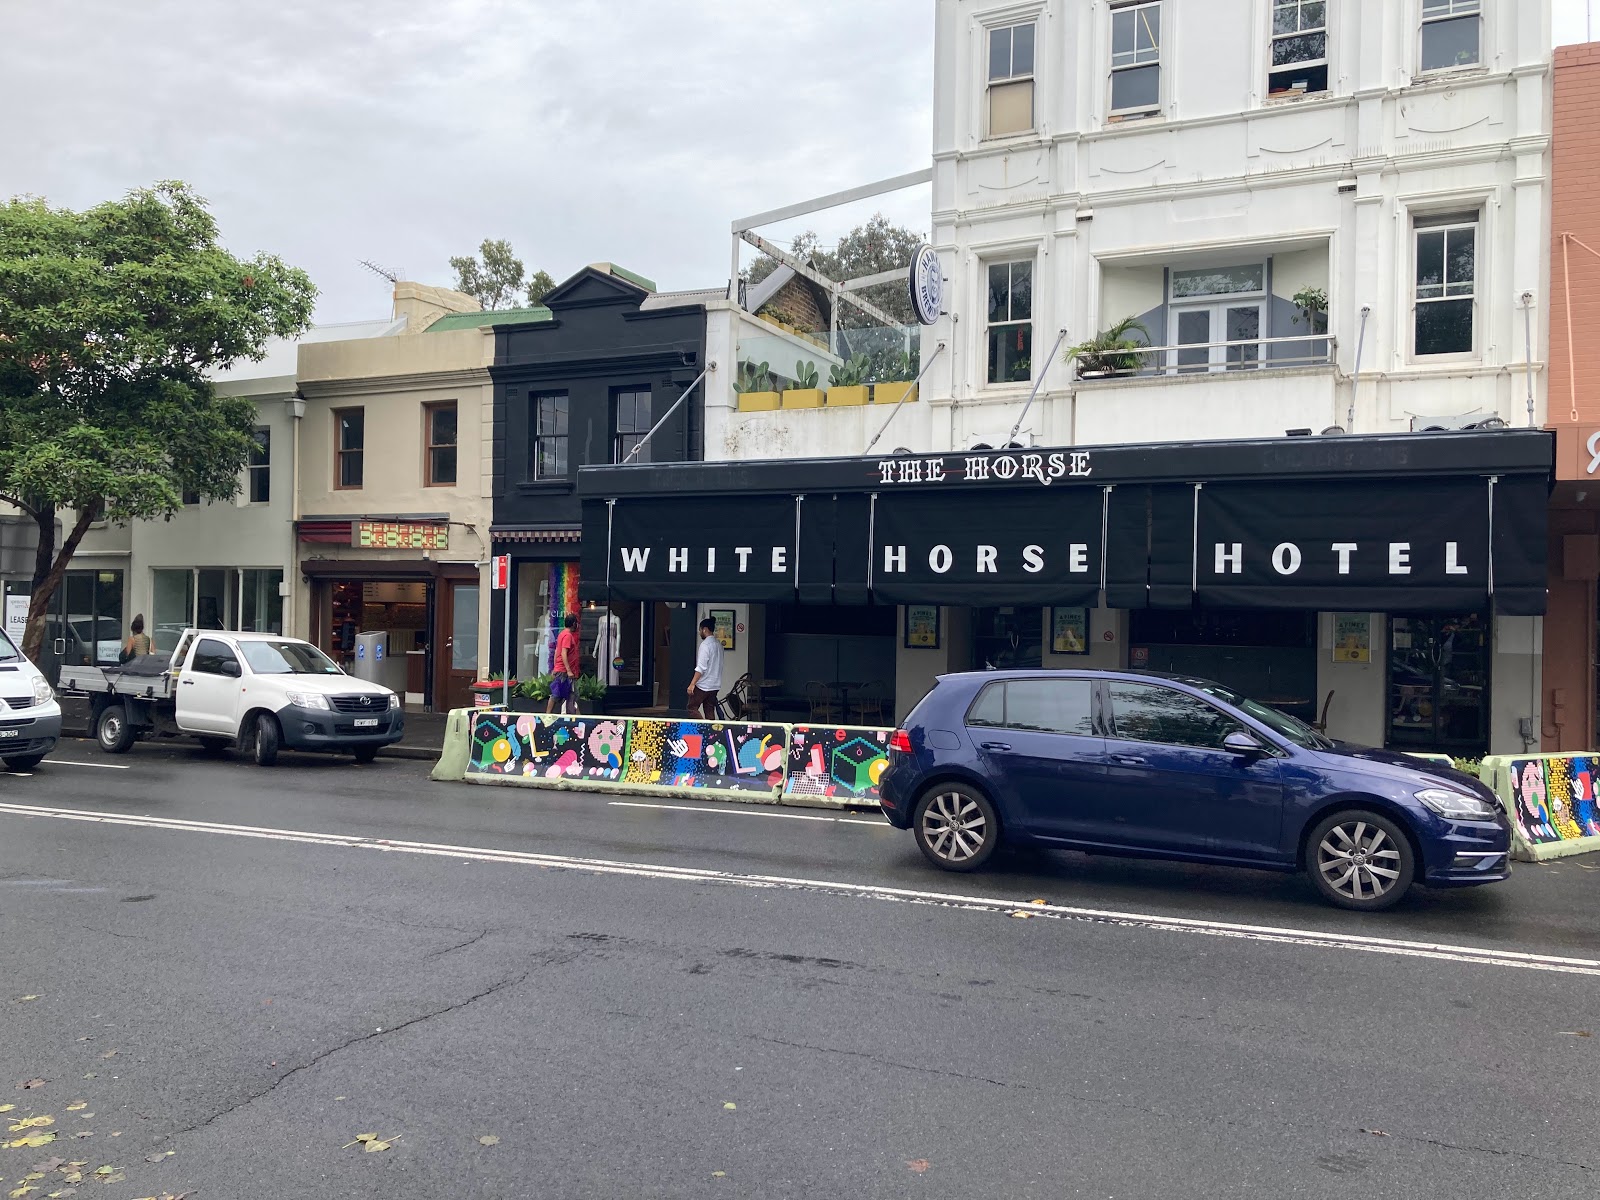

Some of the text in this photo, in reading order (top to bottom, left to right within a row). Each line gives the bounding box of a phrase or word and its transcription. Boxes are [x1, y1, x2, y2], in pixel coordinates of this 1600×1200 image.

[877, 450, 1093, 486] THE HORSE
[620, 541, 1468, 575] WHITE HORSE HOTEL
